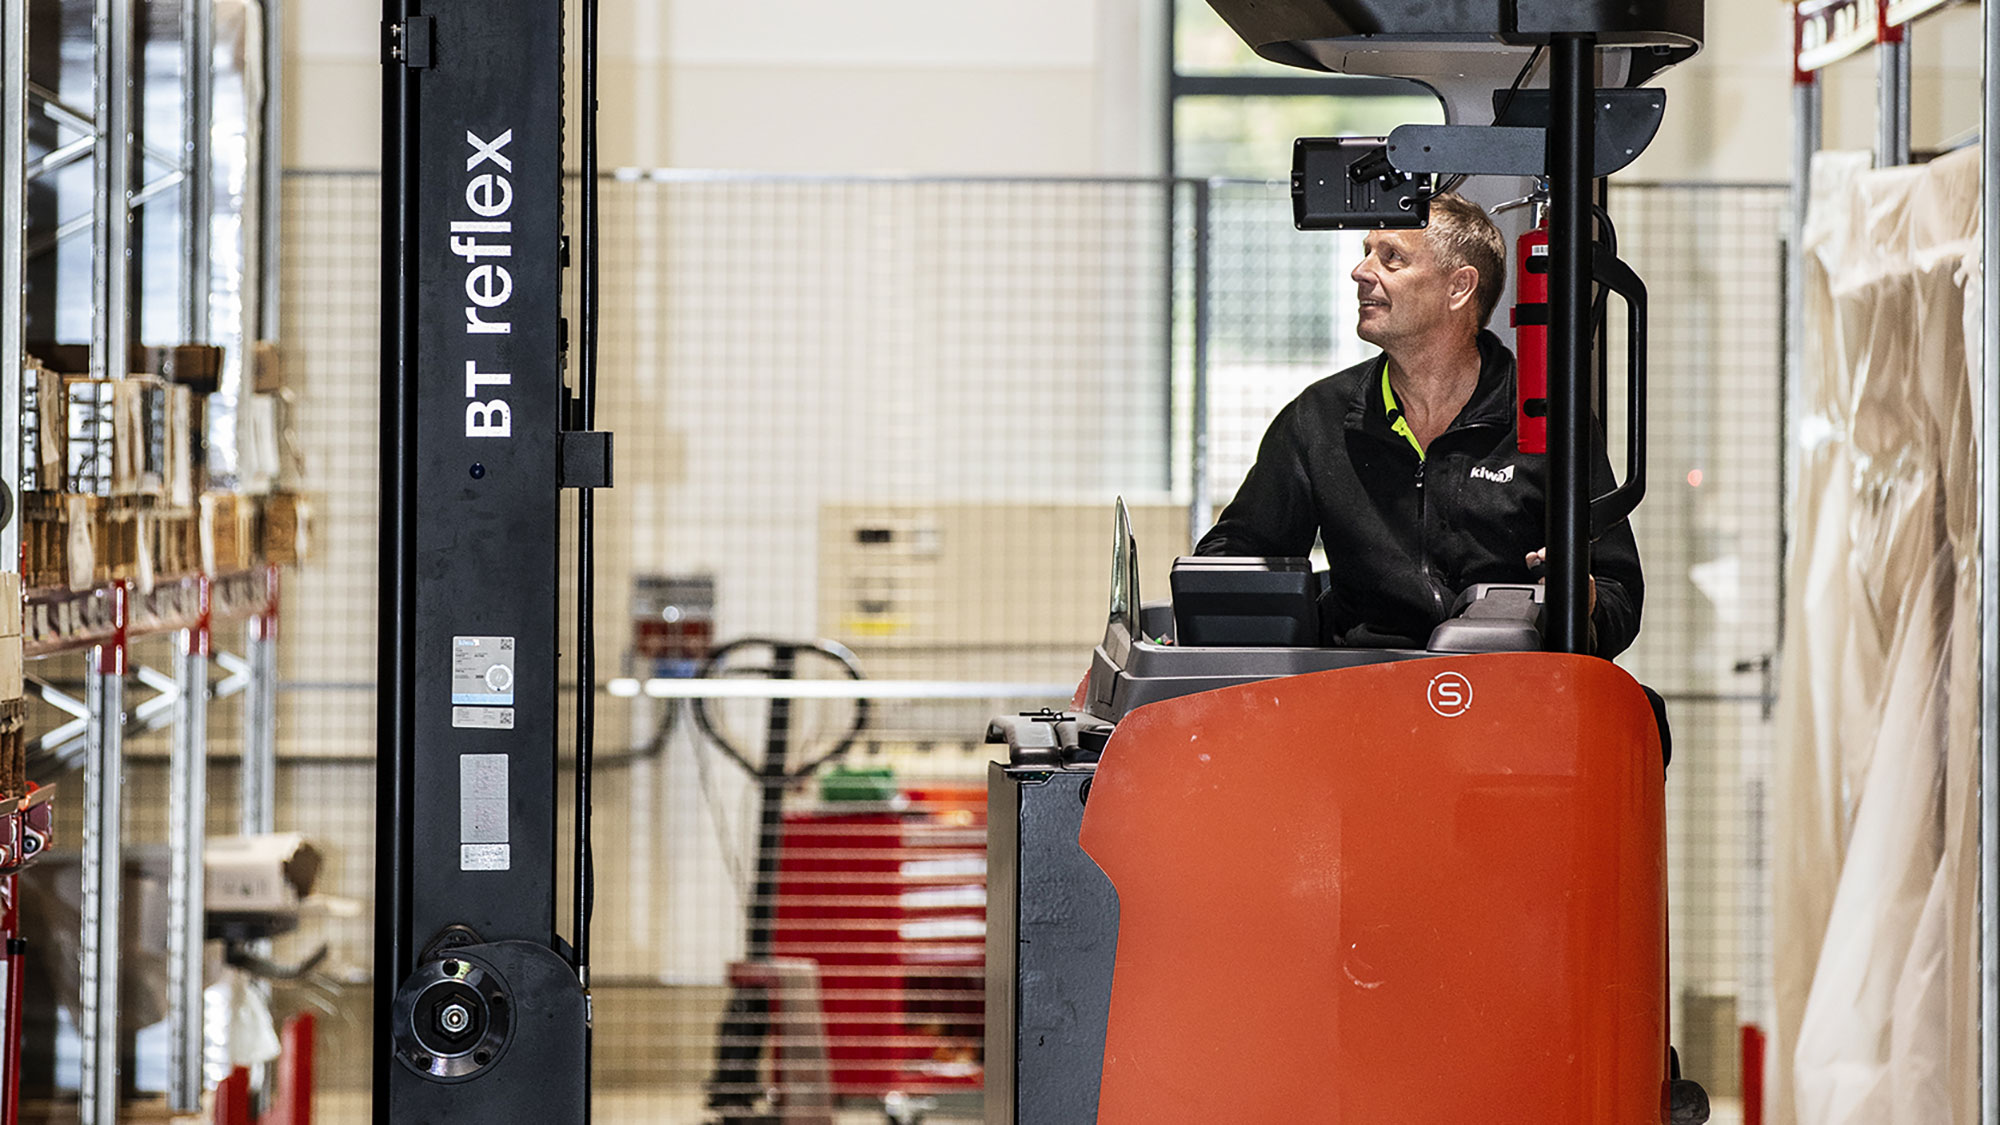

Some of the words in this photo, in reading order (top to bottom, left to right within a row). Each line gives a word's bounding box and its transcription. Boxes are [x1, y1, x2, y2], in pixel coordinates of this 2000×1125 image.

[450, 128, 513, 333] reflex
[465, 360, 511, 437] BT
[1470, 466, 1507, 483] kiwa
[1438, 683, 1462, 706] S
